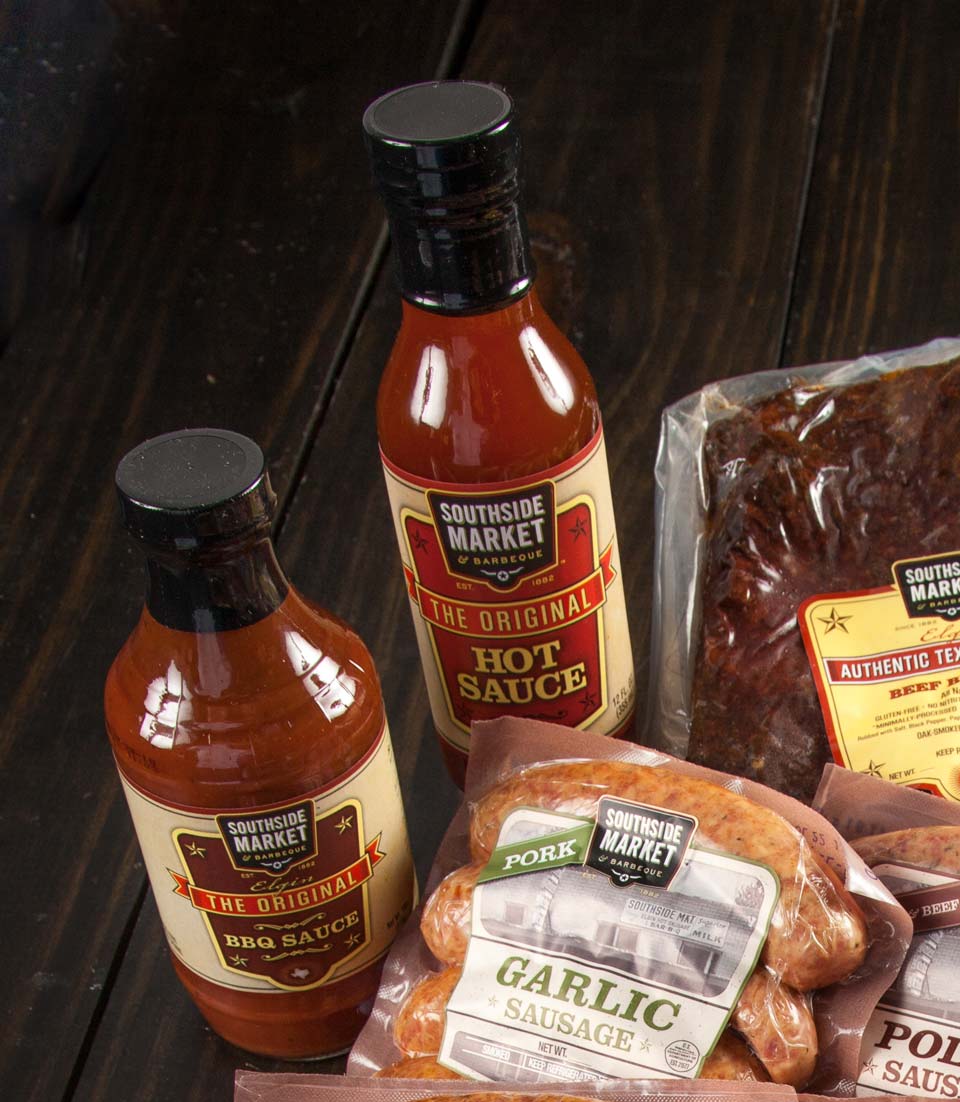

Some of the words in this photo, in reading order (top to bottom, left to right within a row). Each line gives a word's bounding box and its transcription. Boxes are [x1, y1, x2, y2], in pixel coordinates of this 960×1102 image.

[440, 495, 545, 522] SOUTHSIDE
[448, 518, 545, 552] MARKET
[458, 555, 469, 564] &
[474, 550, 543, 565] BARBEQUE
[430, 600, 467, 629] THE
[480, 588, 591, 632] ORIGINAL
[471, 640, 560, 673] HOT
[840, 652, 930, 679] AUTHENTIC
[457, 662, 587, 704] SAUCE
[889, 681, 942, 699] BEEF
[936, 748, 954, 757] KEEP
[889, 771, 902, 780] NET
[227, 810, 307, 834] SOUTHSIDE
[606, 808, 683, 844] SOUTHSIDE
[234, 825, 307, 852] MARKET
[600, 830, 677, 867] MARKET
[255, 846, 307, 860] BARBEQUE
[503, 838, 577, 870] PORK
[610, 858, 662, 878] BARBEQUE
[206, 894, 246, 912] THE
[257, 872, 357, 912] ORIGINAL
[250, 876, 313, 896] Elgin
[628, 900, 675, 919] SOUTHSIDE
[922, 899, 959, 916] BEEF
[224, 934, 276, 948] BBQ
[282, 911, 359, 947] SAUCE
[496, 956, 680, 1030] GARLIC
[504, 997, 634, 1052] SAUSAGE
[538, 1041, 552, 1052] NET
[553, 1047, 567, 1057] WT.
